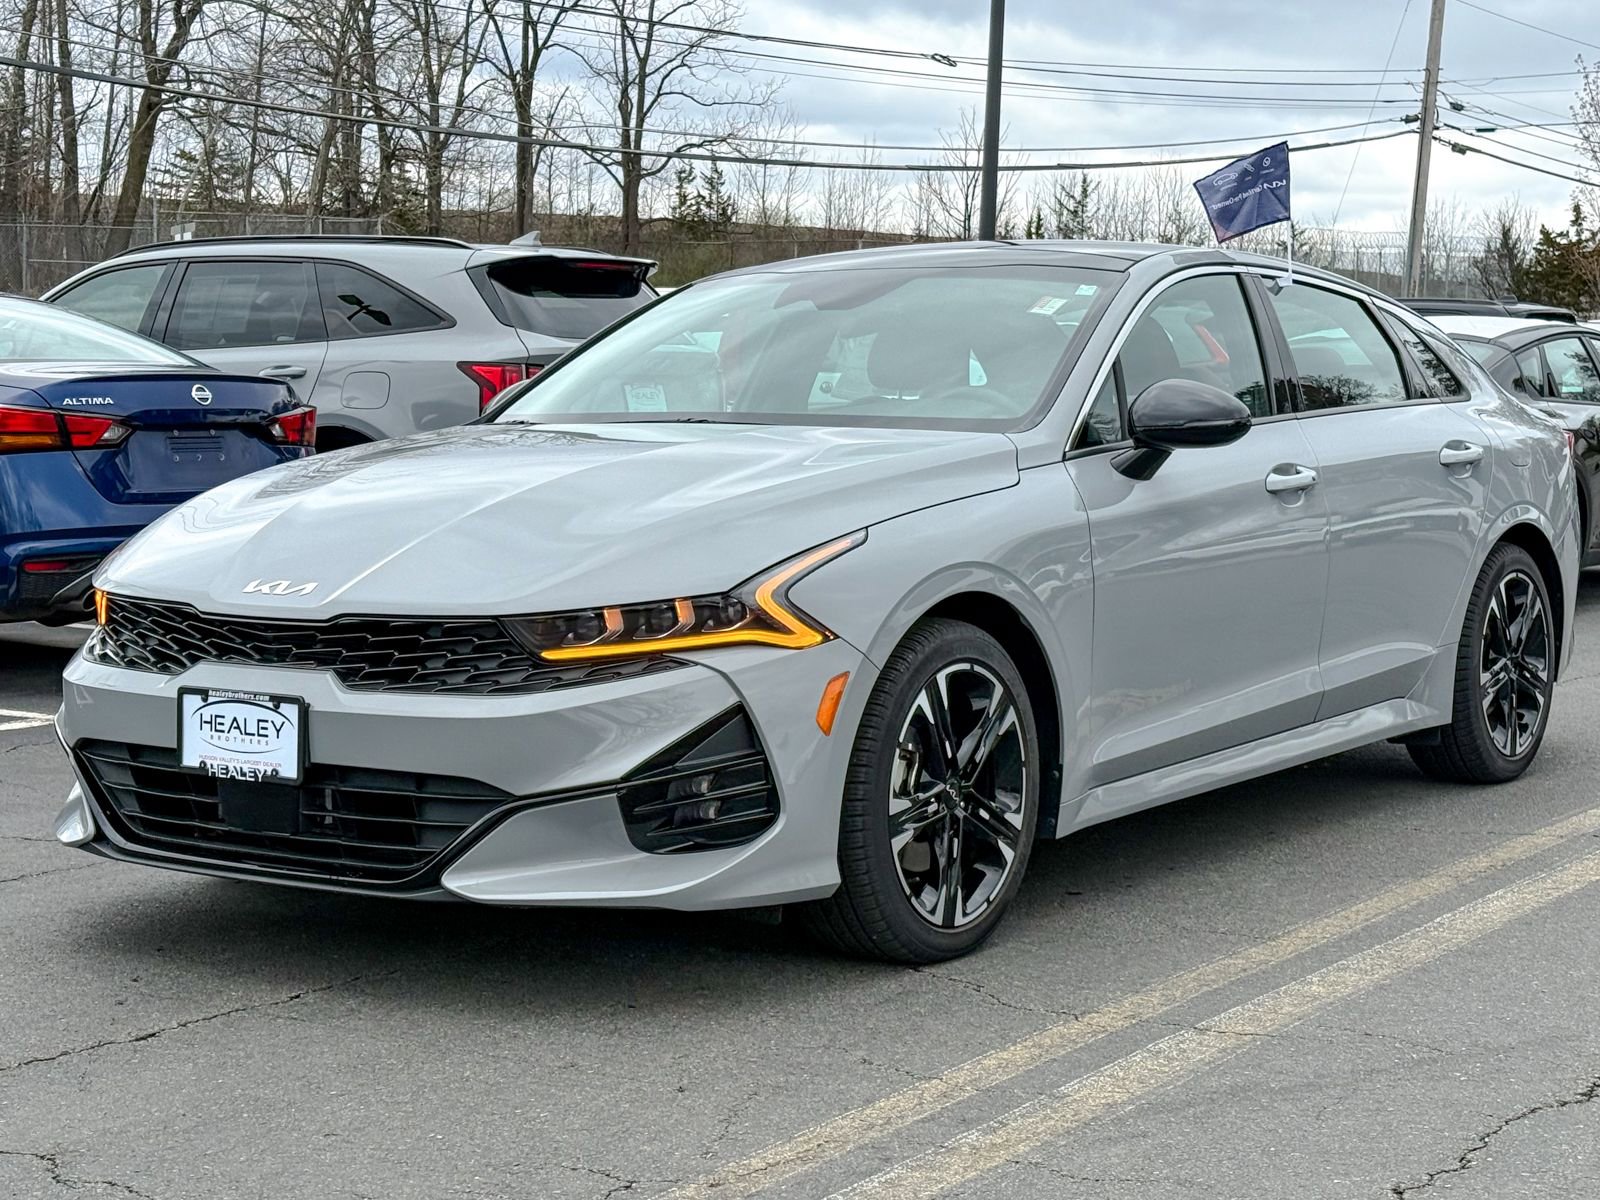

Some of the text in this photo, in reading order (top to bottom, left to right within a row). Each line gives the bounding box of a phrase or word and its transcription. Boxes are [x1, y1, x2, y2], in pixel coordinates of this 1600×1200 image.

[62, 397, 114, 405] ALTIMA
[242, 579, 319, 596] KIA
[208, 689, 270, 701] healeybrothers.com
[200, 712, 285, 739] HEALEY
[210, 734, 269, 746] BROTHERS
[198, 754, 218, 762] HUDSON
[241, 759, 261, 767] LARGEST
[208, 764, 265, 782] HEALEY
